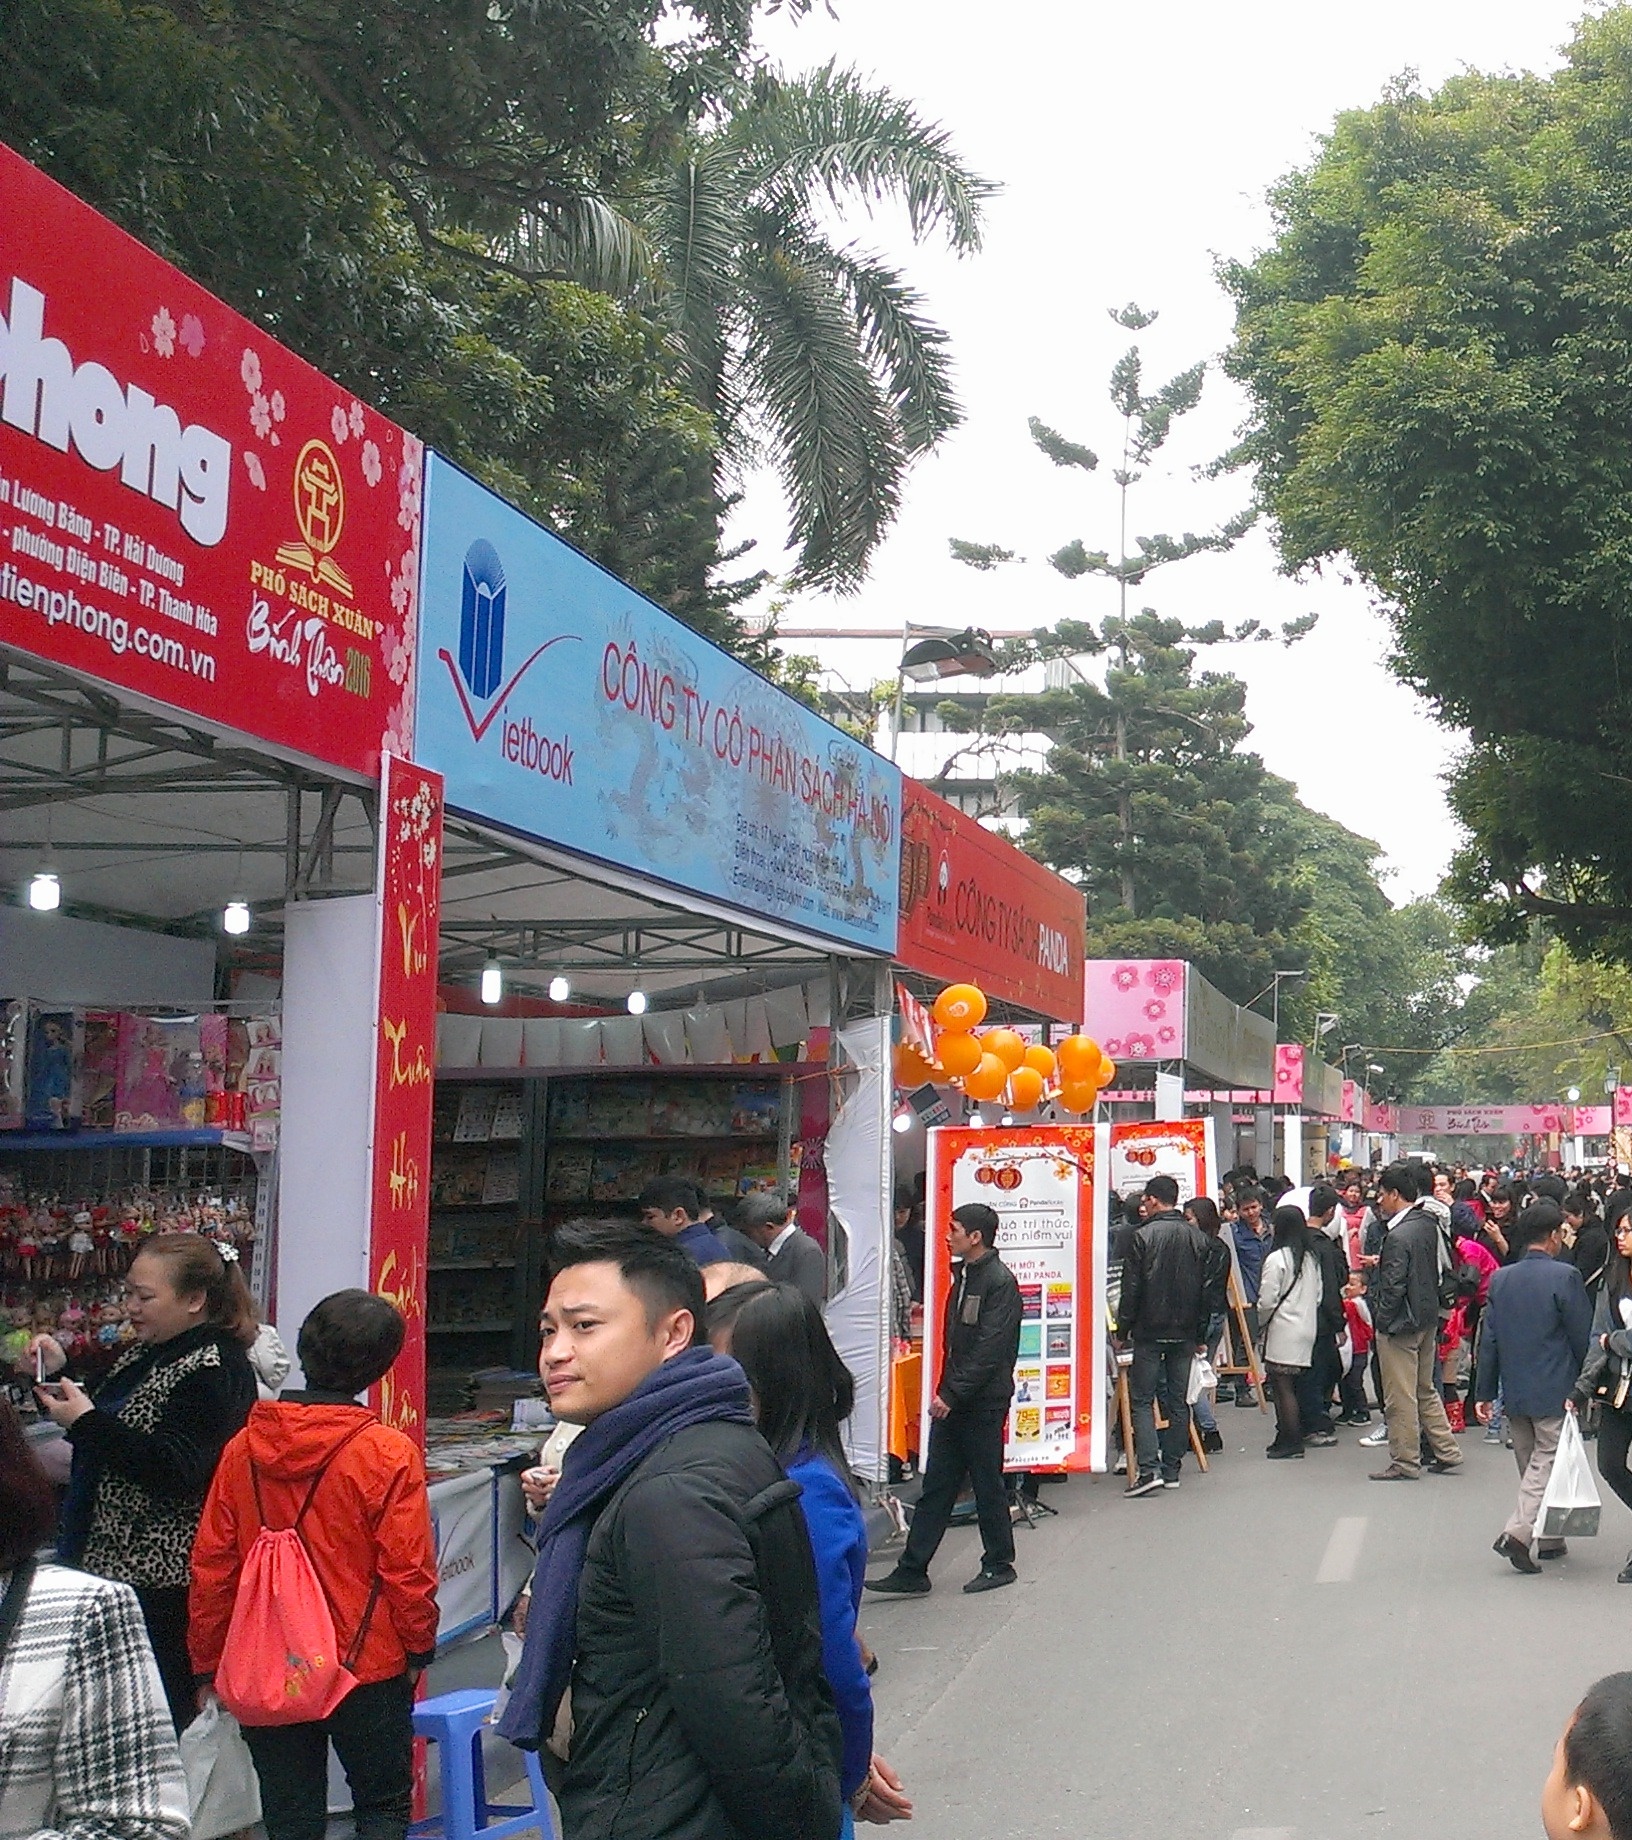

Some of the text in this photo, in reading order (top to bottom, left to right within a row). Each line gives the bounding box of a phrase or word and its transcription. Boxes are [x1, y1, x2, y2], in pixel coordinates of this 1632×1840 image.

[0, 275, 232, 547] hong
[12, 525, 218, 637] phường Điện Biên TP. Thanh Hóa
[13, 479, 55, 527] Lương
[57, 501, 93, 544] Băng
[103, 523, 121, 555] TP.
[124, 533, 145, 566] Hải
[147, 544, 185, 587] Dương
[250, 560, 374, 641] PHỐ SÁCH XUÂN
[603, 640, 676, 731] CÔNG
[682, 685, 710, 747] TY
[713, 705, 744, 767] CỔ
[801, 755, 845, 819] SÁCH
[955, 878, 996, 943] CÔNG
[1038, 923, 1070, 977] PANDA
[1034, 1271, 1062, 1279] PANDA
